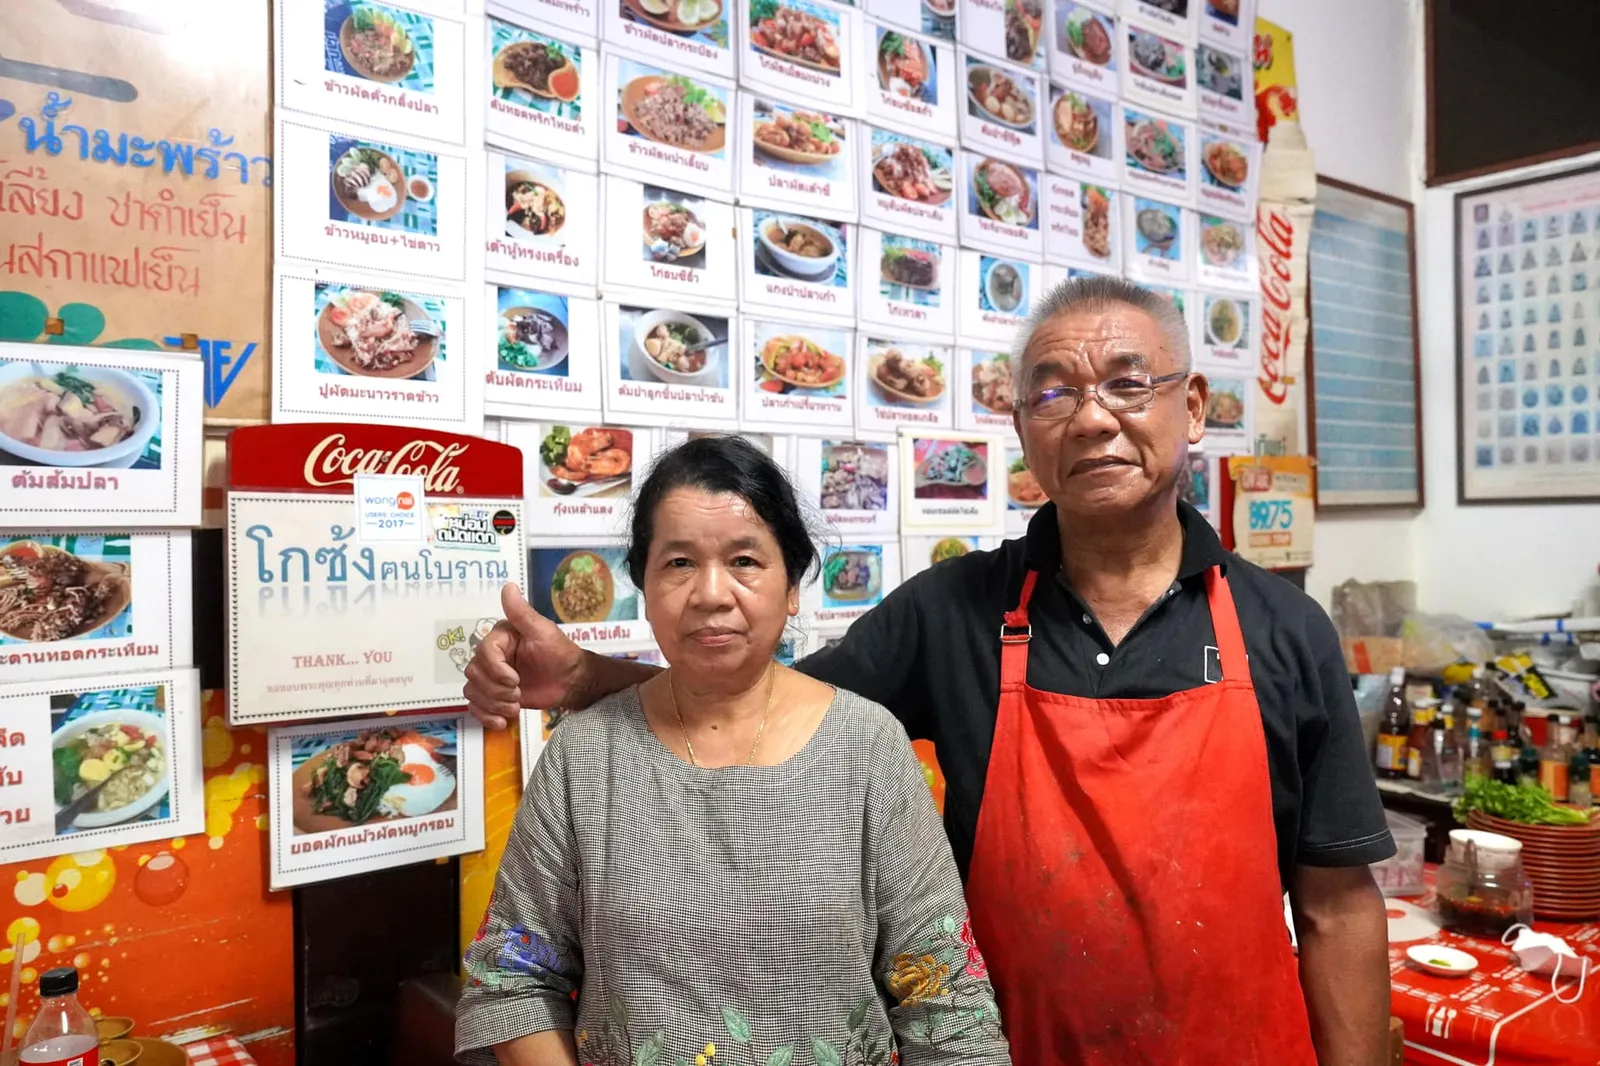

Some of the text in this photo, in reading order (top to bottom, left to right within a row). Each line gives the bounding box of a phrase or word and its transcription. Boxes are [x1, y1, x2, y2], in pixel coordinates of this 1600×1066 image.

[323, 79, 440, 115] ข้าวผัดคั่วกลิ้งปลา
[18, 91, 274, 188] น้ำมะพร้าว
[107, 188, 247, 244] ชาดำเย็น
[323, 223, 441, 252] ข้าวหมูอบ+ไข่ดาว
[485, 237, 580, 268] เต้าหู้ทรงเครื่อง
[318, 382, 440, 404] ปูผัดมะนาวราดข้าว
[485, 370, 583, 394] ตับผัดกระเทียม
[303, 432, 470, 493] Coca-Cola
[11, 469, 120, 490] ต้มส้มปลา
[378, 519, 405, 529] 2017
[553, 502, 614, 519] กุ้งเหล้าแดง
[245, 524, 376, 583] โกซ้ง
[436, 625, 466, 651] OK!
[567, 626, 631, 643] ผัดไข่เค็ม
[362, 650, 393, 664] YOU
[290, 816, 455, 856] ยอดผักแม้วผัดหมูกรอบ
